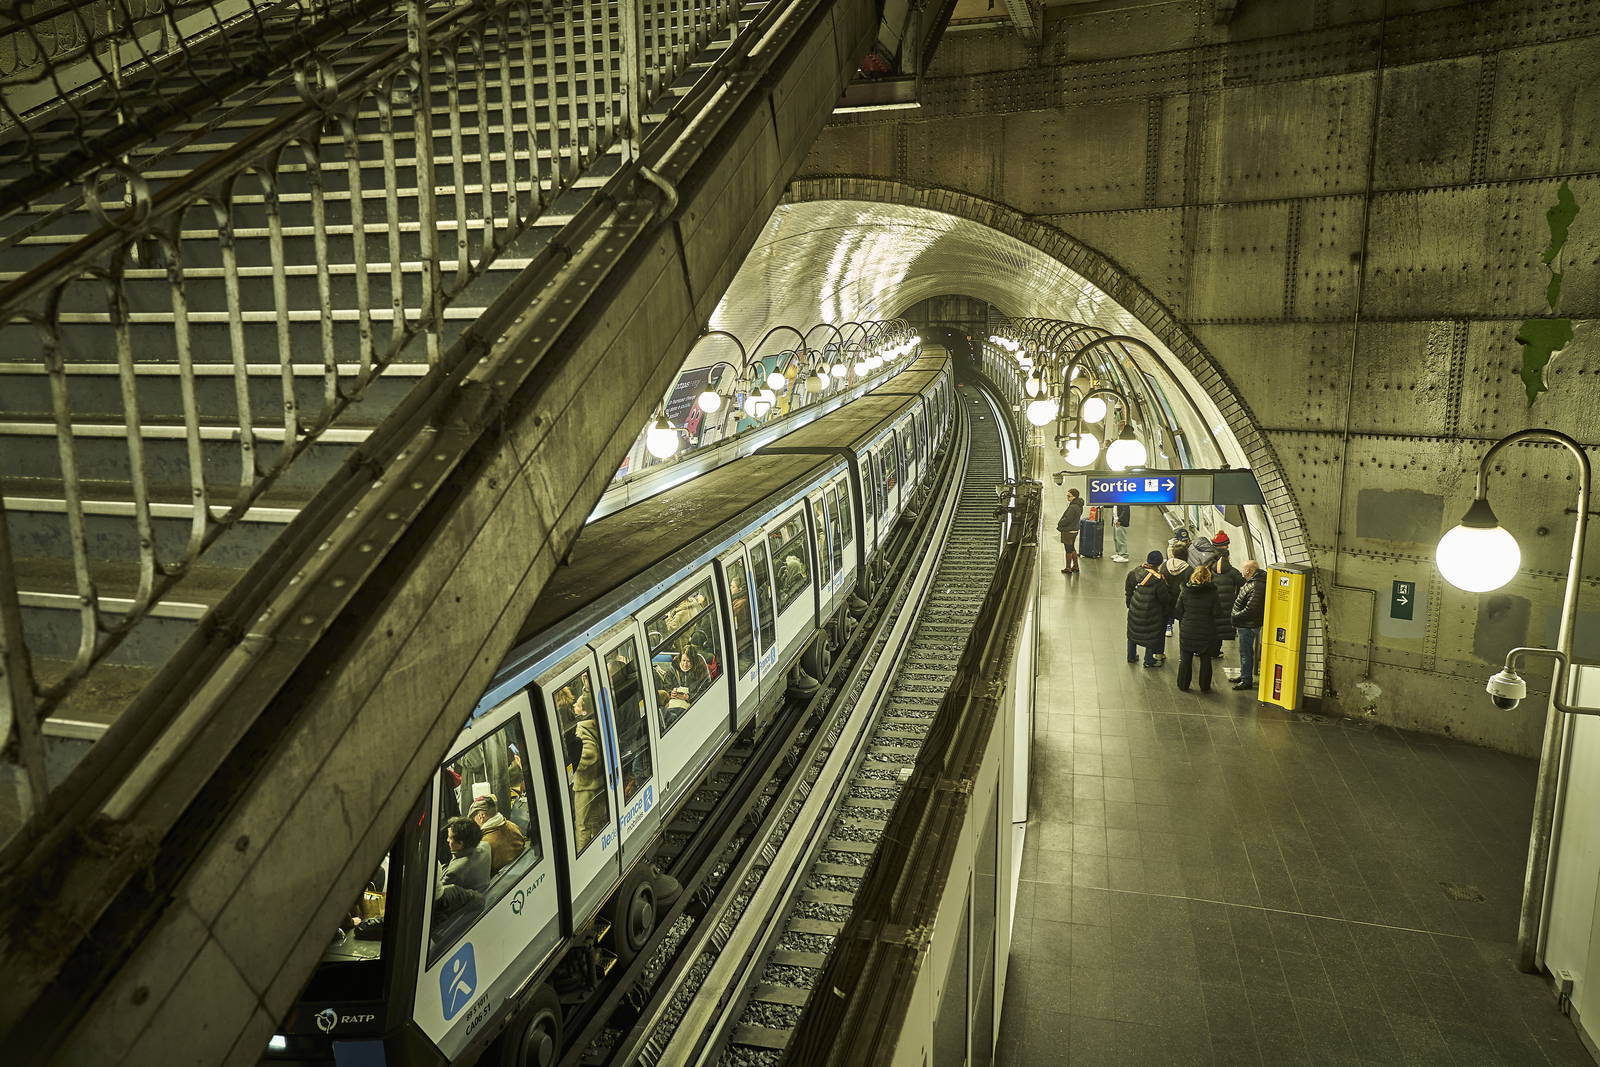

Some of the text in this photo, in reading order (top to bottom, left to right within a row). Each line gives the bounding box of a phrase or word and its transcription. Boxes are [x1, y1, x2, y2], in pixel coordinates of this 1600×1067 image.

[1091, 480, 1136, 492] Sortie
[620, 798, 643, 827] France
[526, 873, 546, 897] RATP
[341, 1014, 375, 1024] RATP
